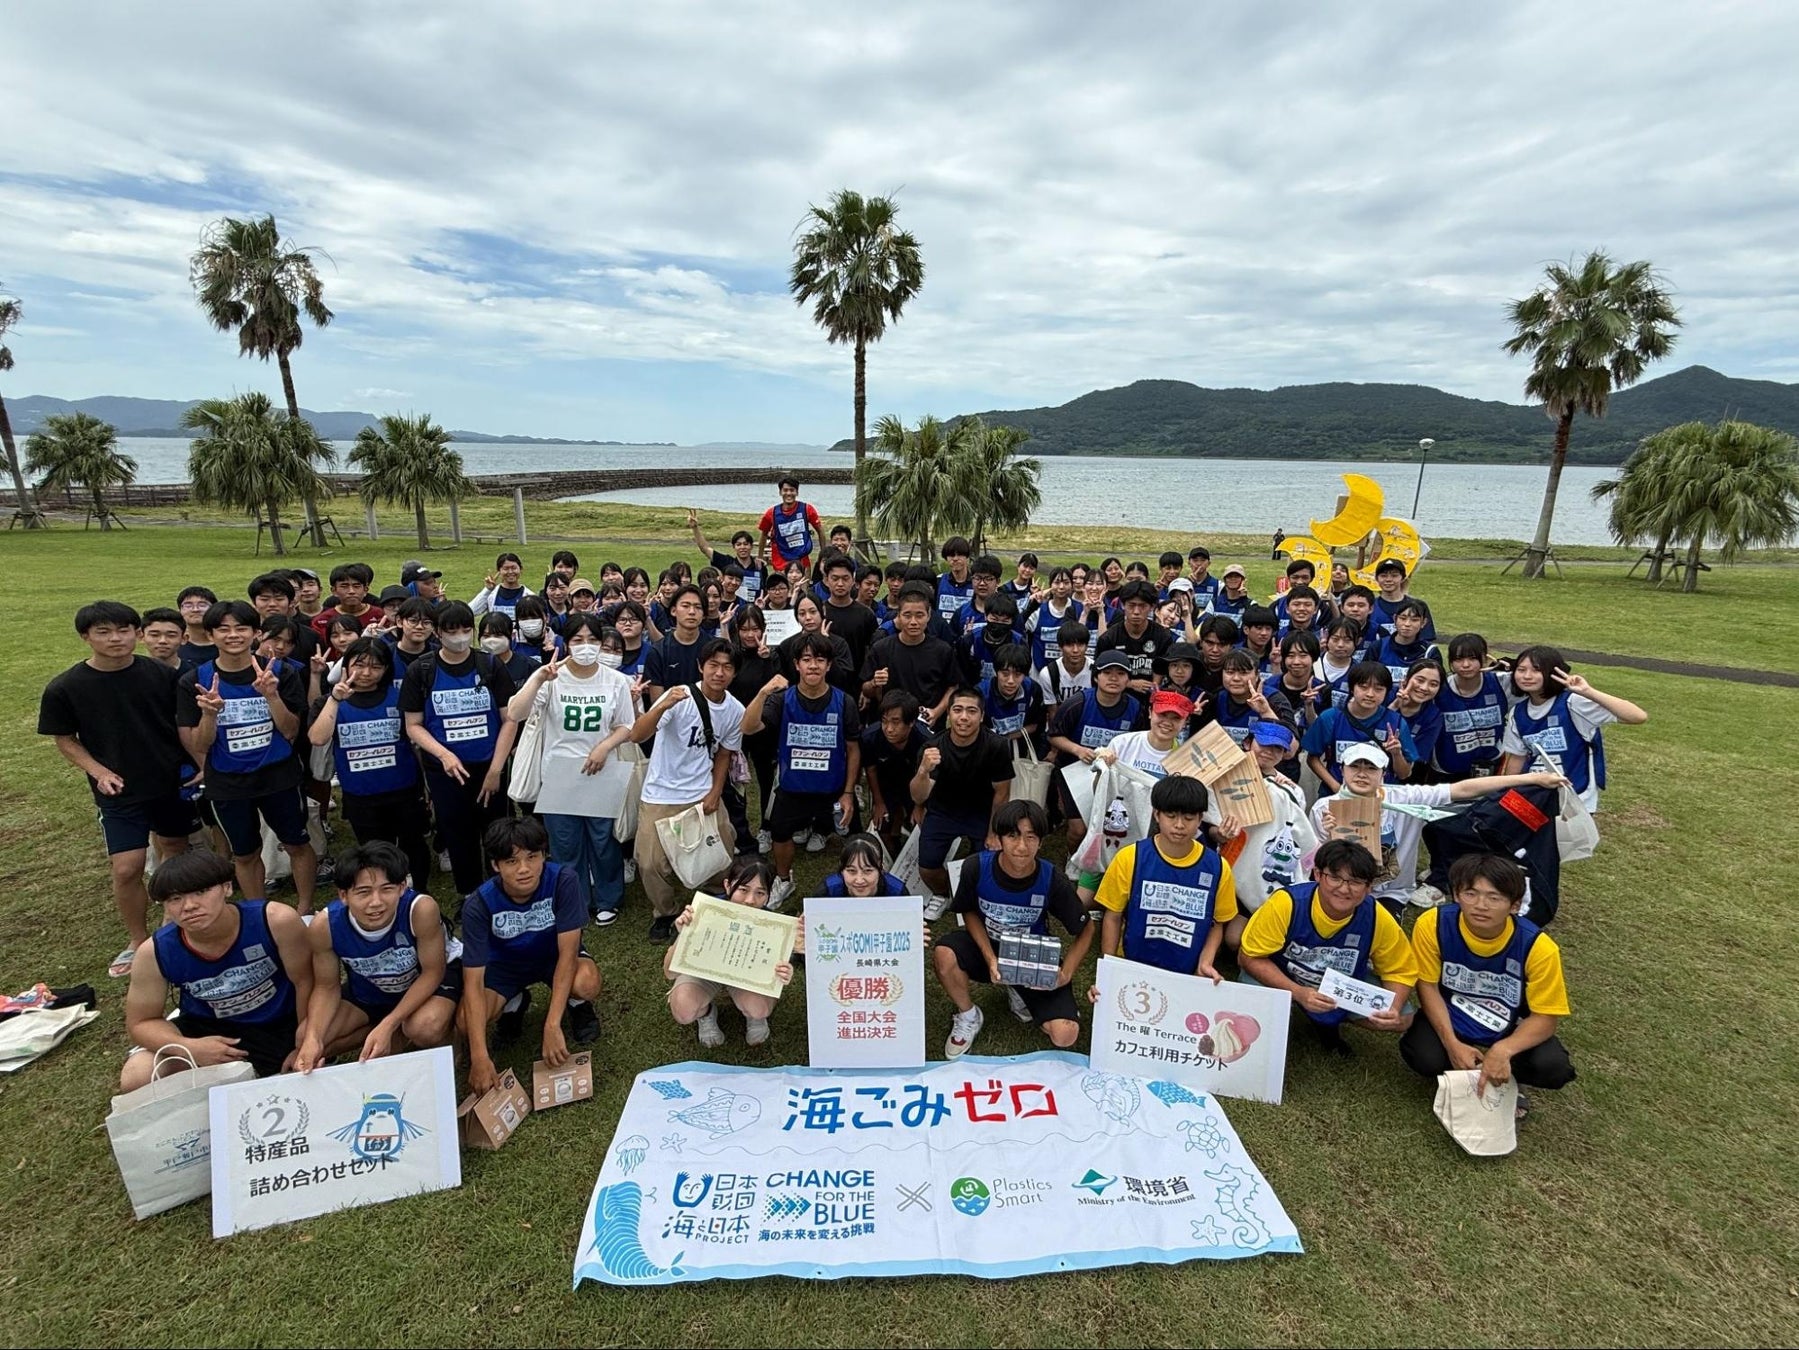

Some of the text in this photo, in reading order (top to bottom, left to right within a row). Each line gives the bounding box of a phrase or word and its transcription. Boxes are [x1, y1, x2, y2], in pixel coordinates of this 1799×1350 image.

[560, 694, 606, 704] MARYLAND
[564, 706, 601, 732] 82
[1172, 887, 1206, 899] CHANGE
[1320, 948, 1355, 958] CHANGE
[856, 958, 899, 968] 長崎県大会
[837, 977, 889, 1000] 優勝
[1134, 992, 1150, 1014] 3
[837, 1011, 897, 1023] 全国大会
[837, 1026, 897, 1039] 進出決定
[1116, 1022, 1197, 1044] The 曜 Terrace
[1115, 1040, 1228, 1071] カフェ利用チケット
[782, 1080, 1059, 1133] 海ごみゼロ
[261, 1108, 288, 1138] 2
[245, 1137, 310, 1166] 特産品
[249, 1154, 394, 1197] 詰め合わせセット
[715, 1174, 758, 1190] 日本
[766, 1169, 875, 1188] CHANGE
[993, 1178, 1052, 1192] Plastics
[1123, 1175, 1190, 1197] 環境省
[712, 1193, 755, 1211] 財団
[815, 1191, 875, 1202] FOR THE
[995, 1192, 1043, 1208] Smart
[1077, 1193, 1196, 1206] Ministry of the Environment
[814, 1203, 875, 1225] BLUE
[662, 1210, 750, 1239] 海と日本
[758, 1222, 875, 1242] 海の未来を変える挑戦
[695, 1233, 750, 1245] PROJECT
